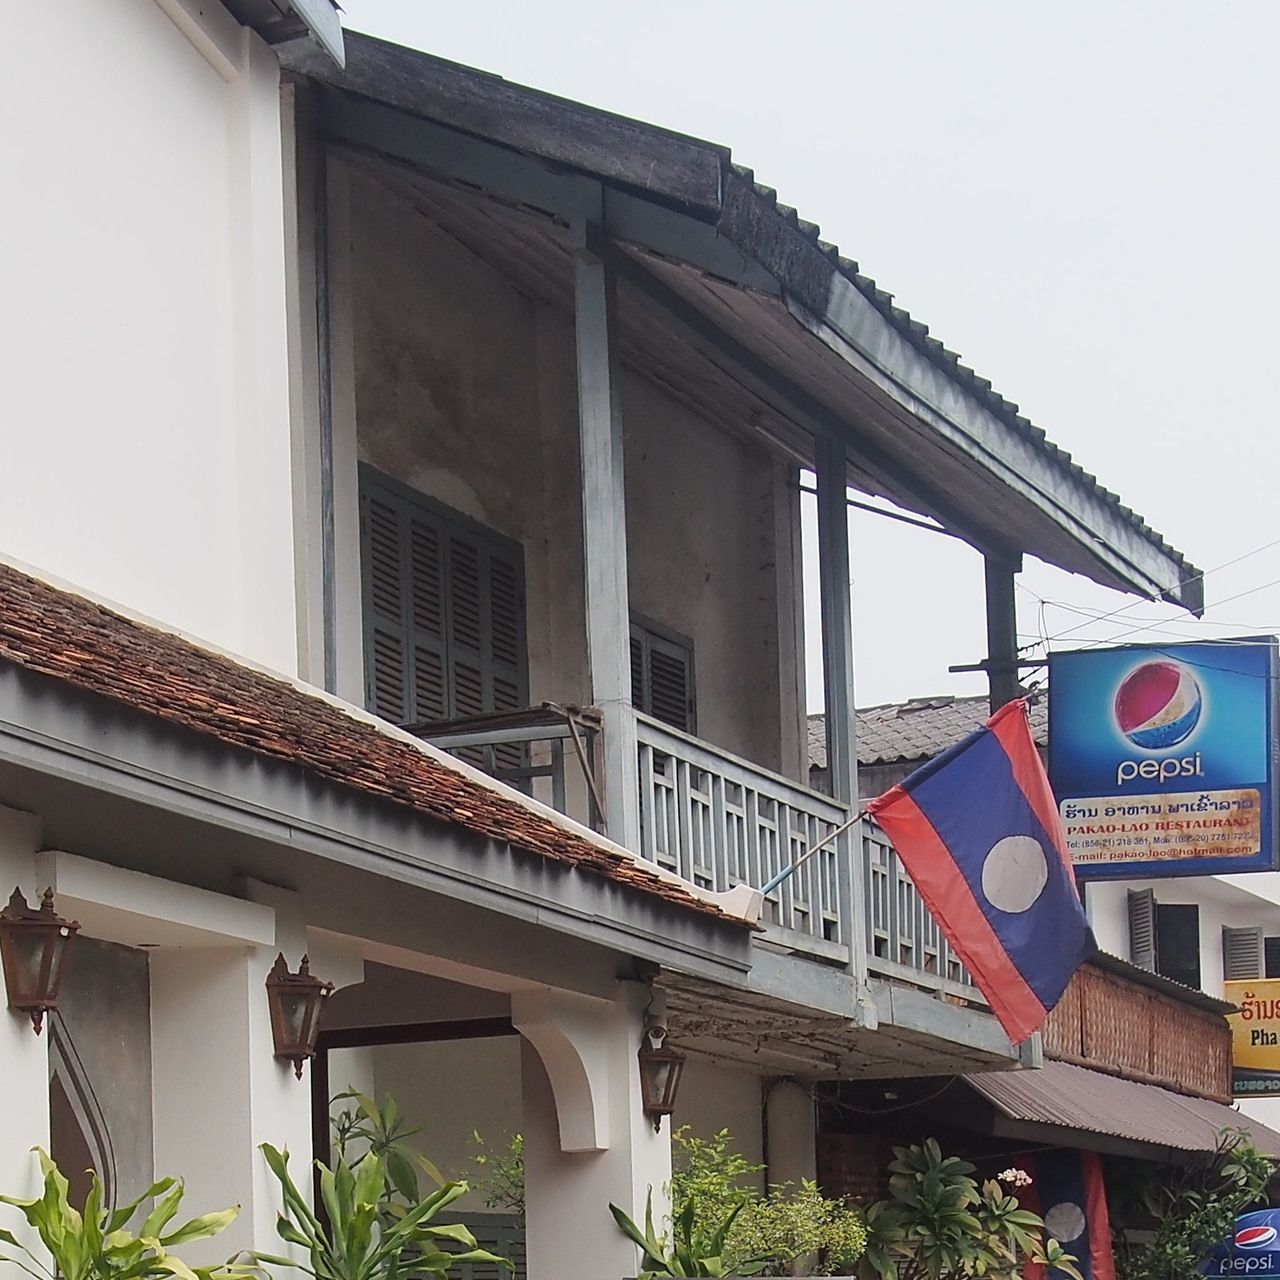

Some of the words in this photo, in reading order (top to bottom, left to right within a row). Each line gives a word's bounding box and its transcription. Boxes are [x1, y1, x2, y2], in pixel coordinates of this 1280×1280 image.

[1118, 751, 1201, 785] pepsi
[1067, 822, 1150, 835] PAKAO-LAO
[1251, 1029, 1278, 1046] Pha
[1220, 1254, 1272, 1274] pepsi
